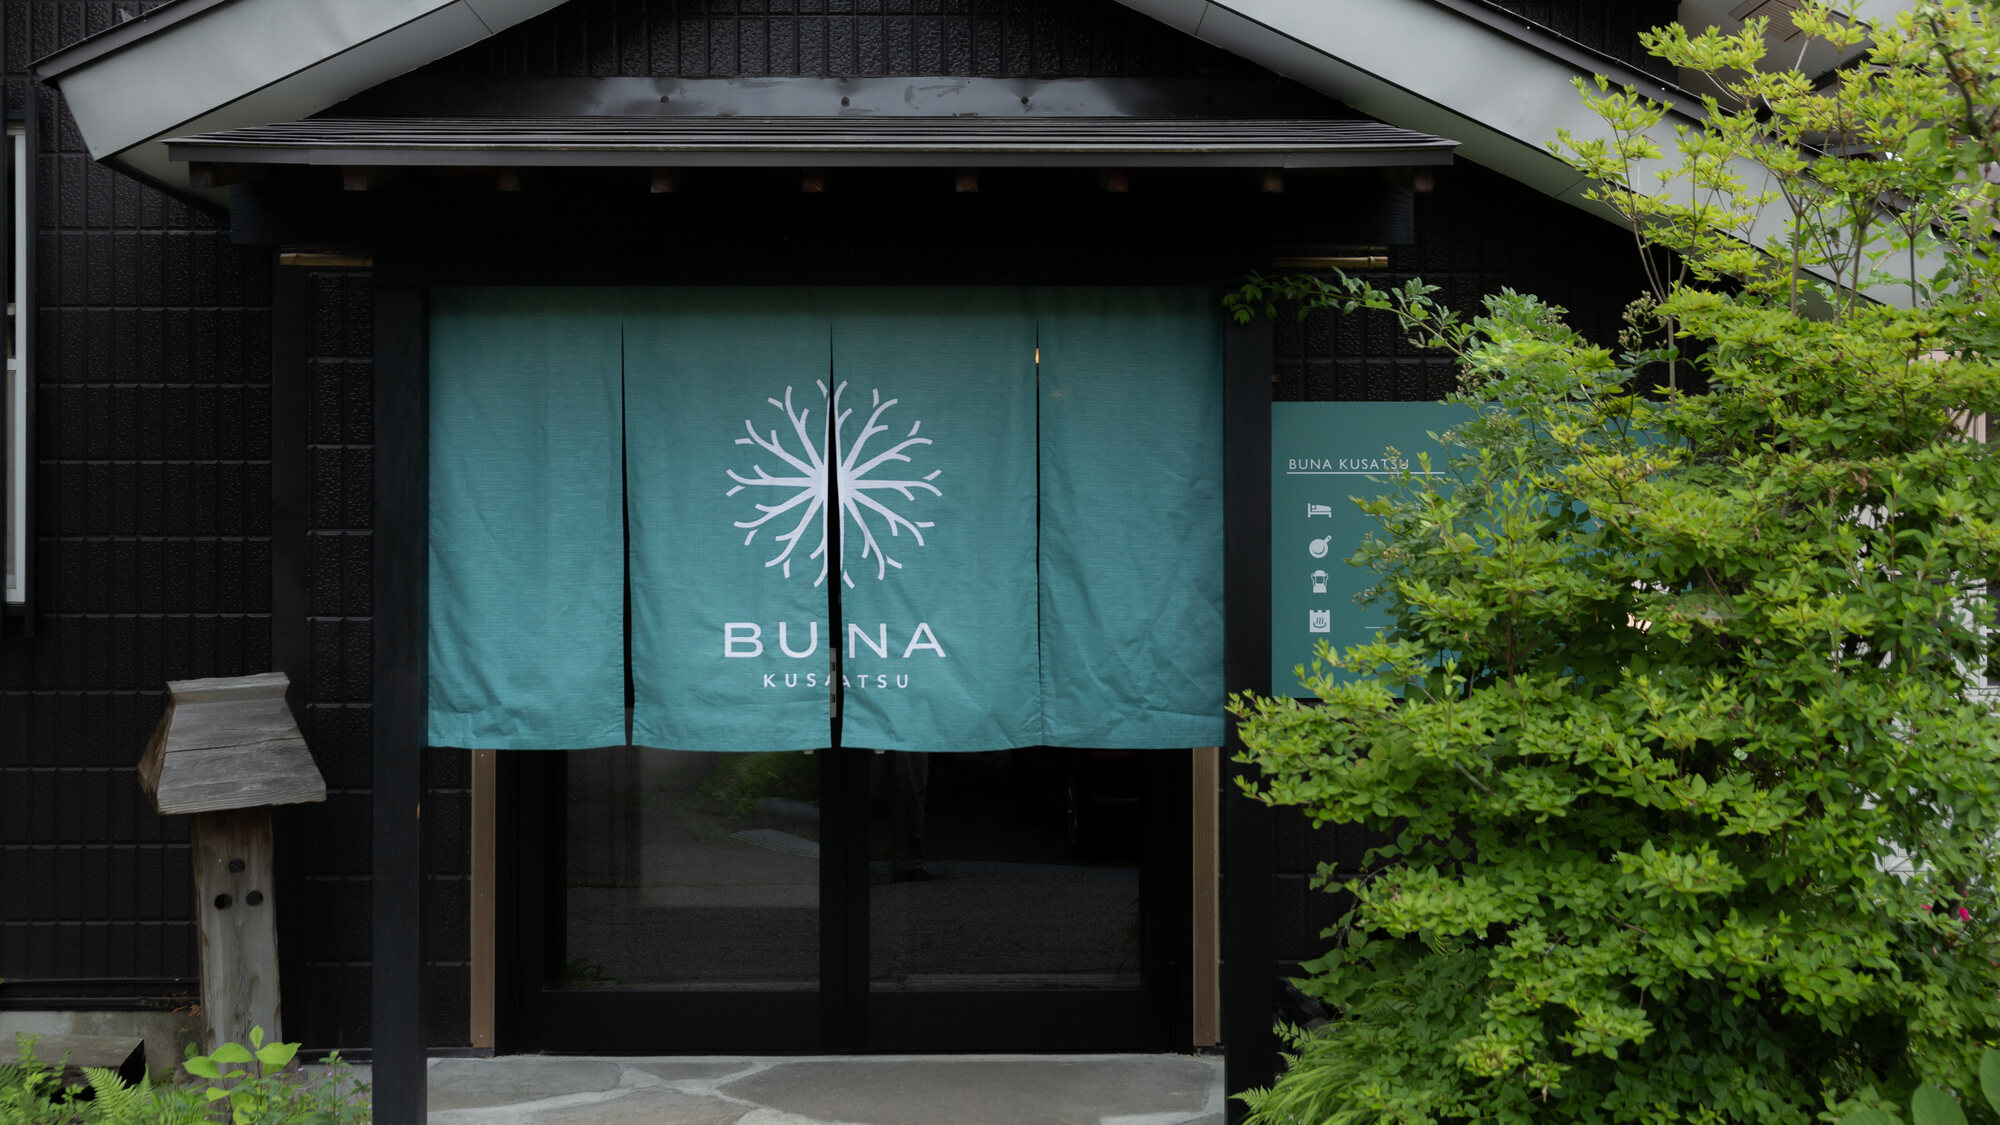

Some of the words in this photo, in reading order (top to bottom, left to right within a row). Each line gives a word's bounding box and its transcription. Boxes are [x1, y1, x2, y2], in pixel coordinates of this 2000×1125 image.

[1289, 458, 1332, 470] BUNA
[1339, 458, 1409, 470] KUSATSU
[724, 621, 947, 659] BUNA
